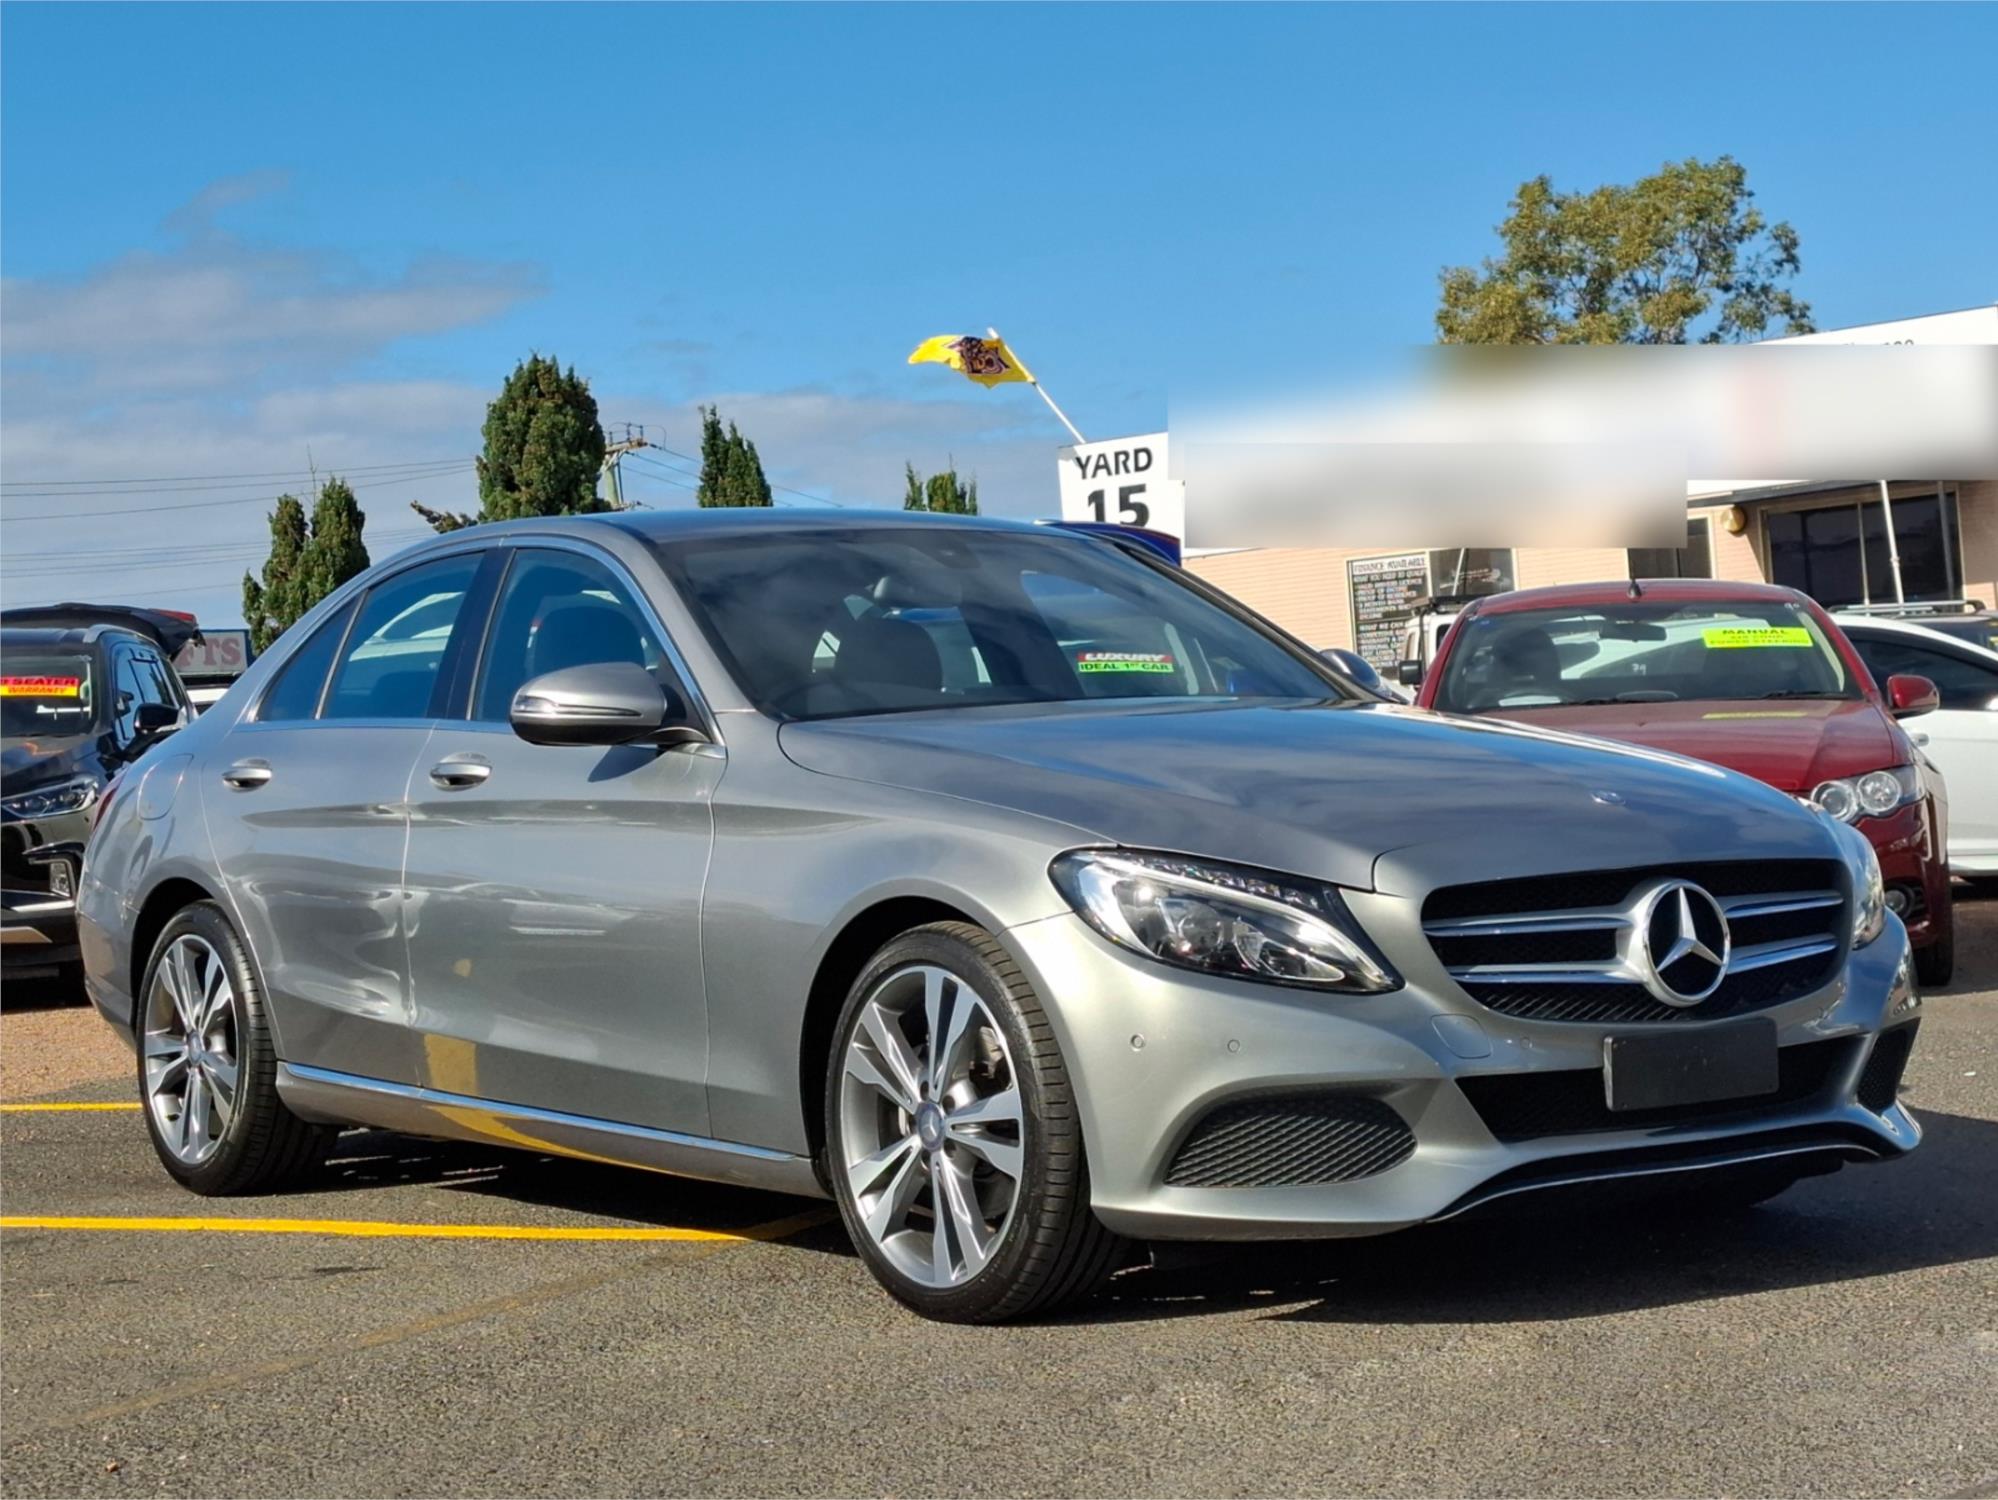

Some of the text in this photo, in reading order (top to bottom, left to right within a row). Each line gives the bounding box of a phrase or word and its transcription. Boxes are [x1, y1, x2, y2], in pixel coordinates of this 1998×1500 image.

[1076, 447, 1153, 480] YARD
[1087, 483, 1150, 527] 15
[1085, 652, 1166, 661] LUXURY
[1080, 662, 1119, 671] IDEAL
[1142, 662, 1170, 671] CAR
[13, 677, 76, 686] SEATER
[8, 686, 67, 694] WARRANTY
